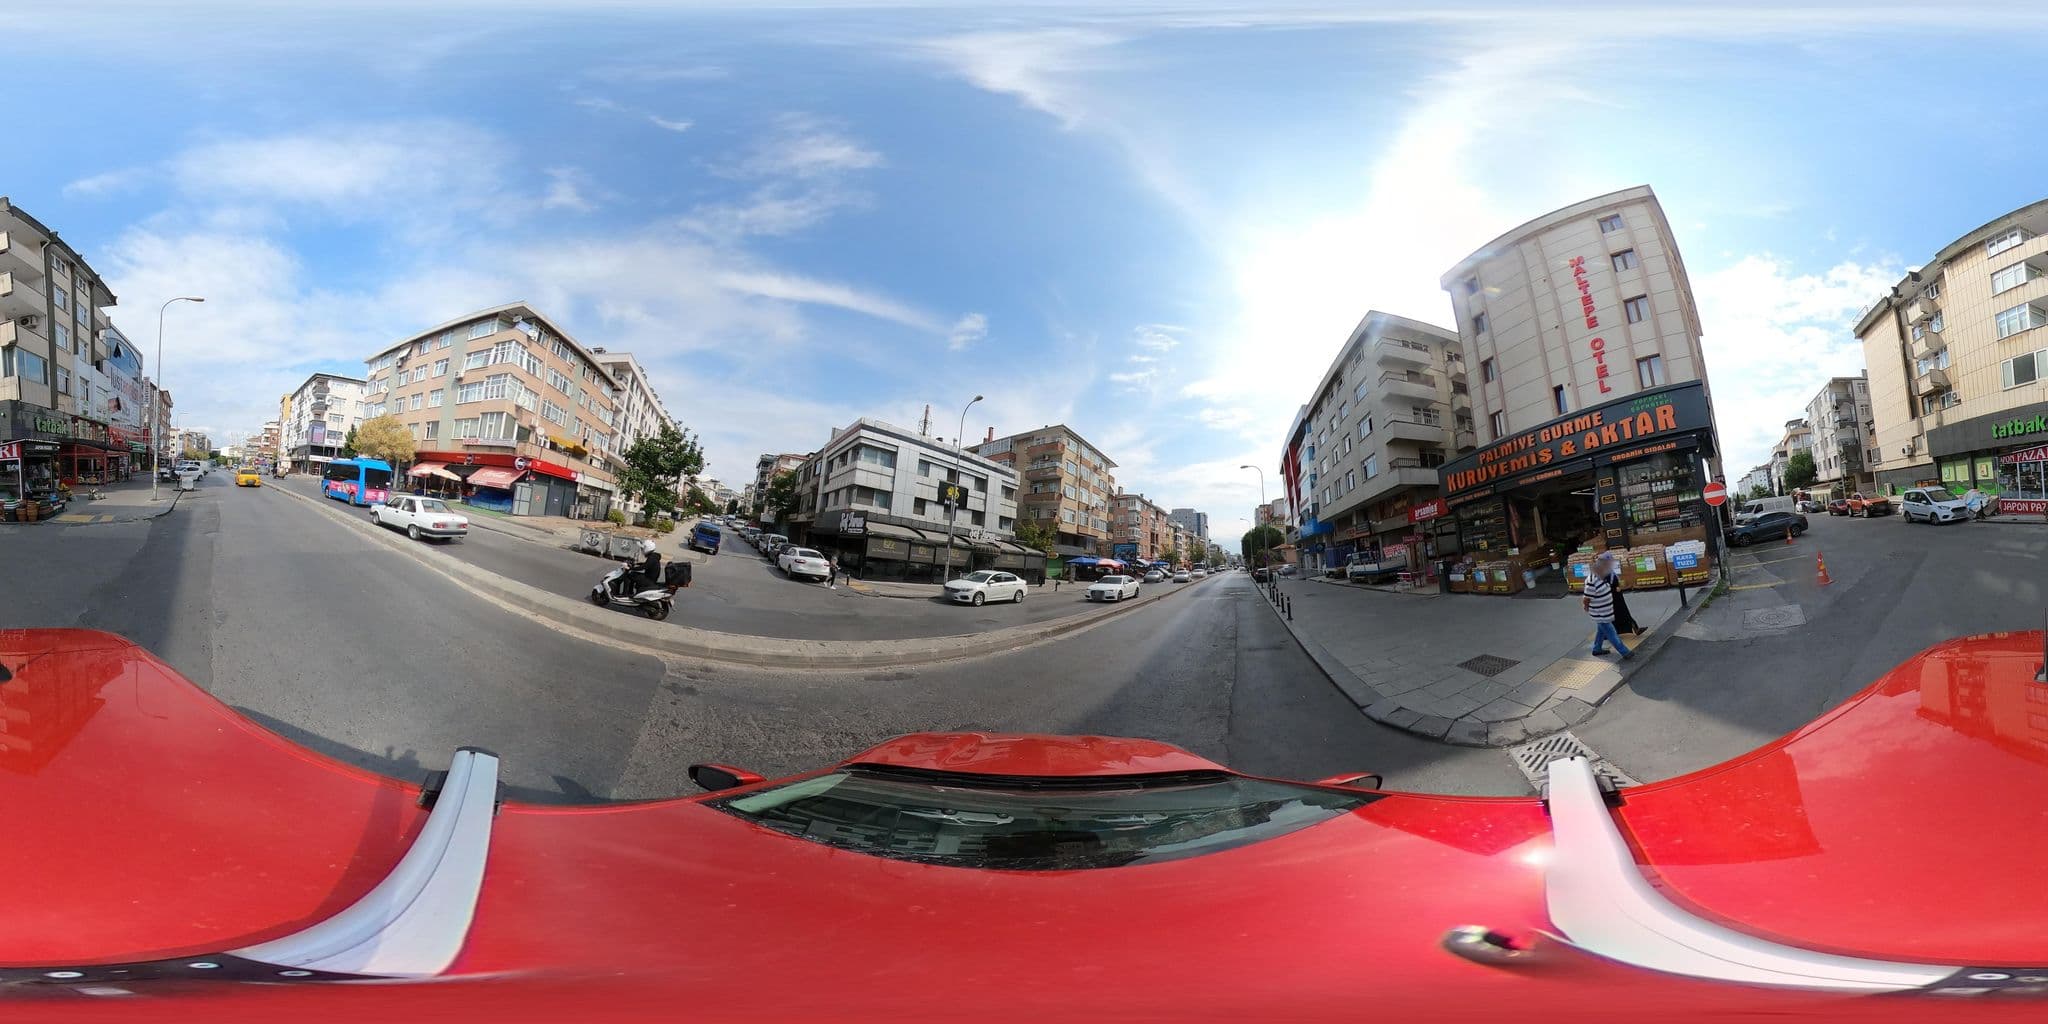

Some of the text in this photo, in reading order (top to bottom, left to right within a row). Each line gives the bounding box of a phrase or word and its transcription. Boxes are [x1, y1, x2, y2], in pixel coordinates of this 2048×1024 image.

[1568, 255, 1612, 394] MALTEPE OTEL
[1447, 404, 1677, 492] KURUYEMİŞ & AKTAR
[1479, 411, 1604, 464] PALMİYE GURME
[2003, 502, 2029, 512] JAPON
